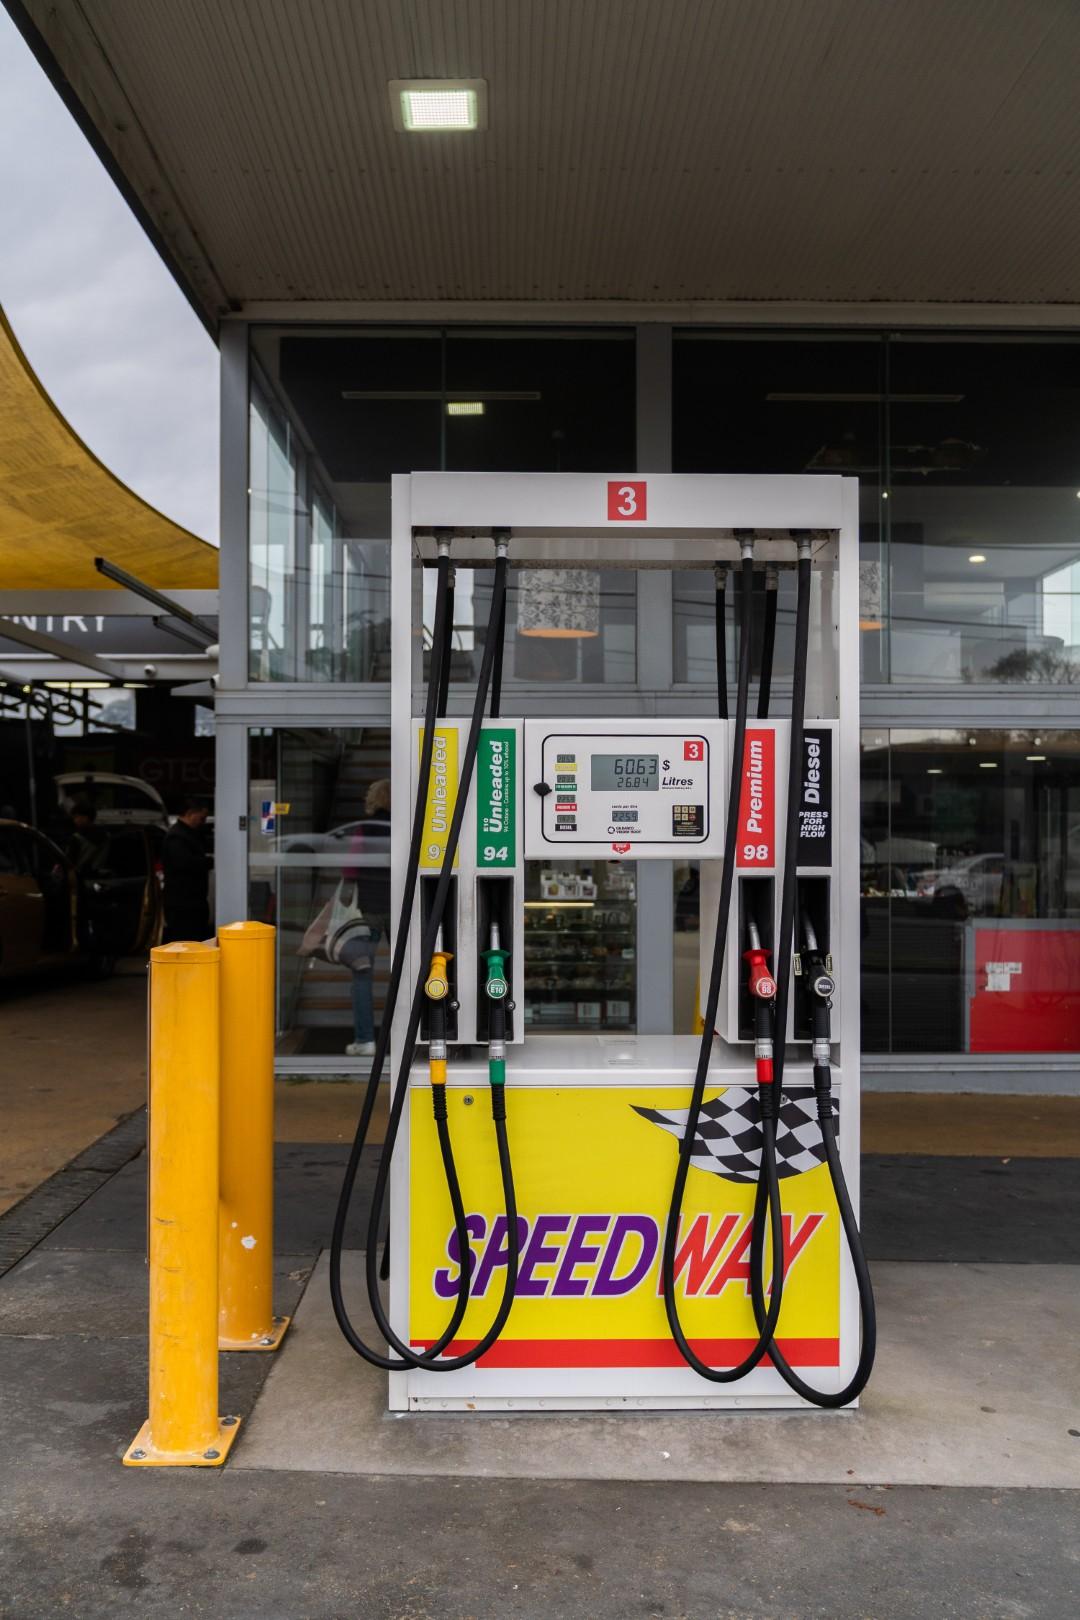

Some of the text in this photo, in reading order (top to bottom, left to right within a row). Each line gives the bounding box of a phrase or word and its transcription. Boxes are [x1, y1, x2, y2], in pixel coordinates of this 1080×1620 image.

[617, 486, 637, 516] 3
[688, 744, 699, 758] 3
[662, 760, 670, 772] $
[804, 737, 820, 805] Diesel
[432, 736, 446, 832] Unleaded
[489, 741, 503, 832] Unleaded
[617, 777, 649, 788] 26.84
[662, 776, 693, 786] Litres
[746, 740, 763, 833] Premium
[483, 846, 508, 861] 94
[743, 844, 769, 860] 98
[434, 1212, 824, 1298] SPEEDWAY
